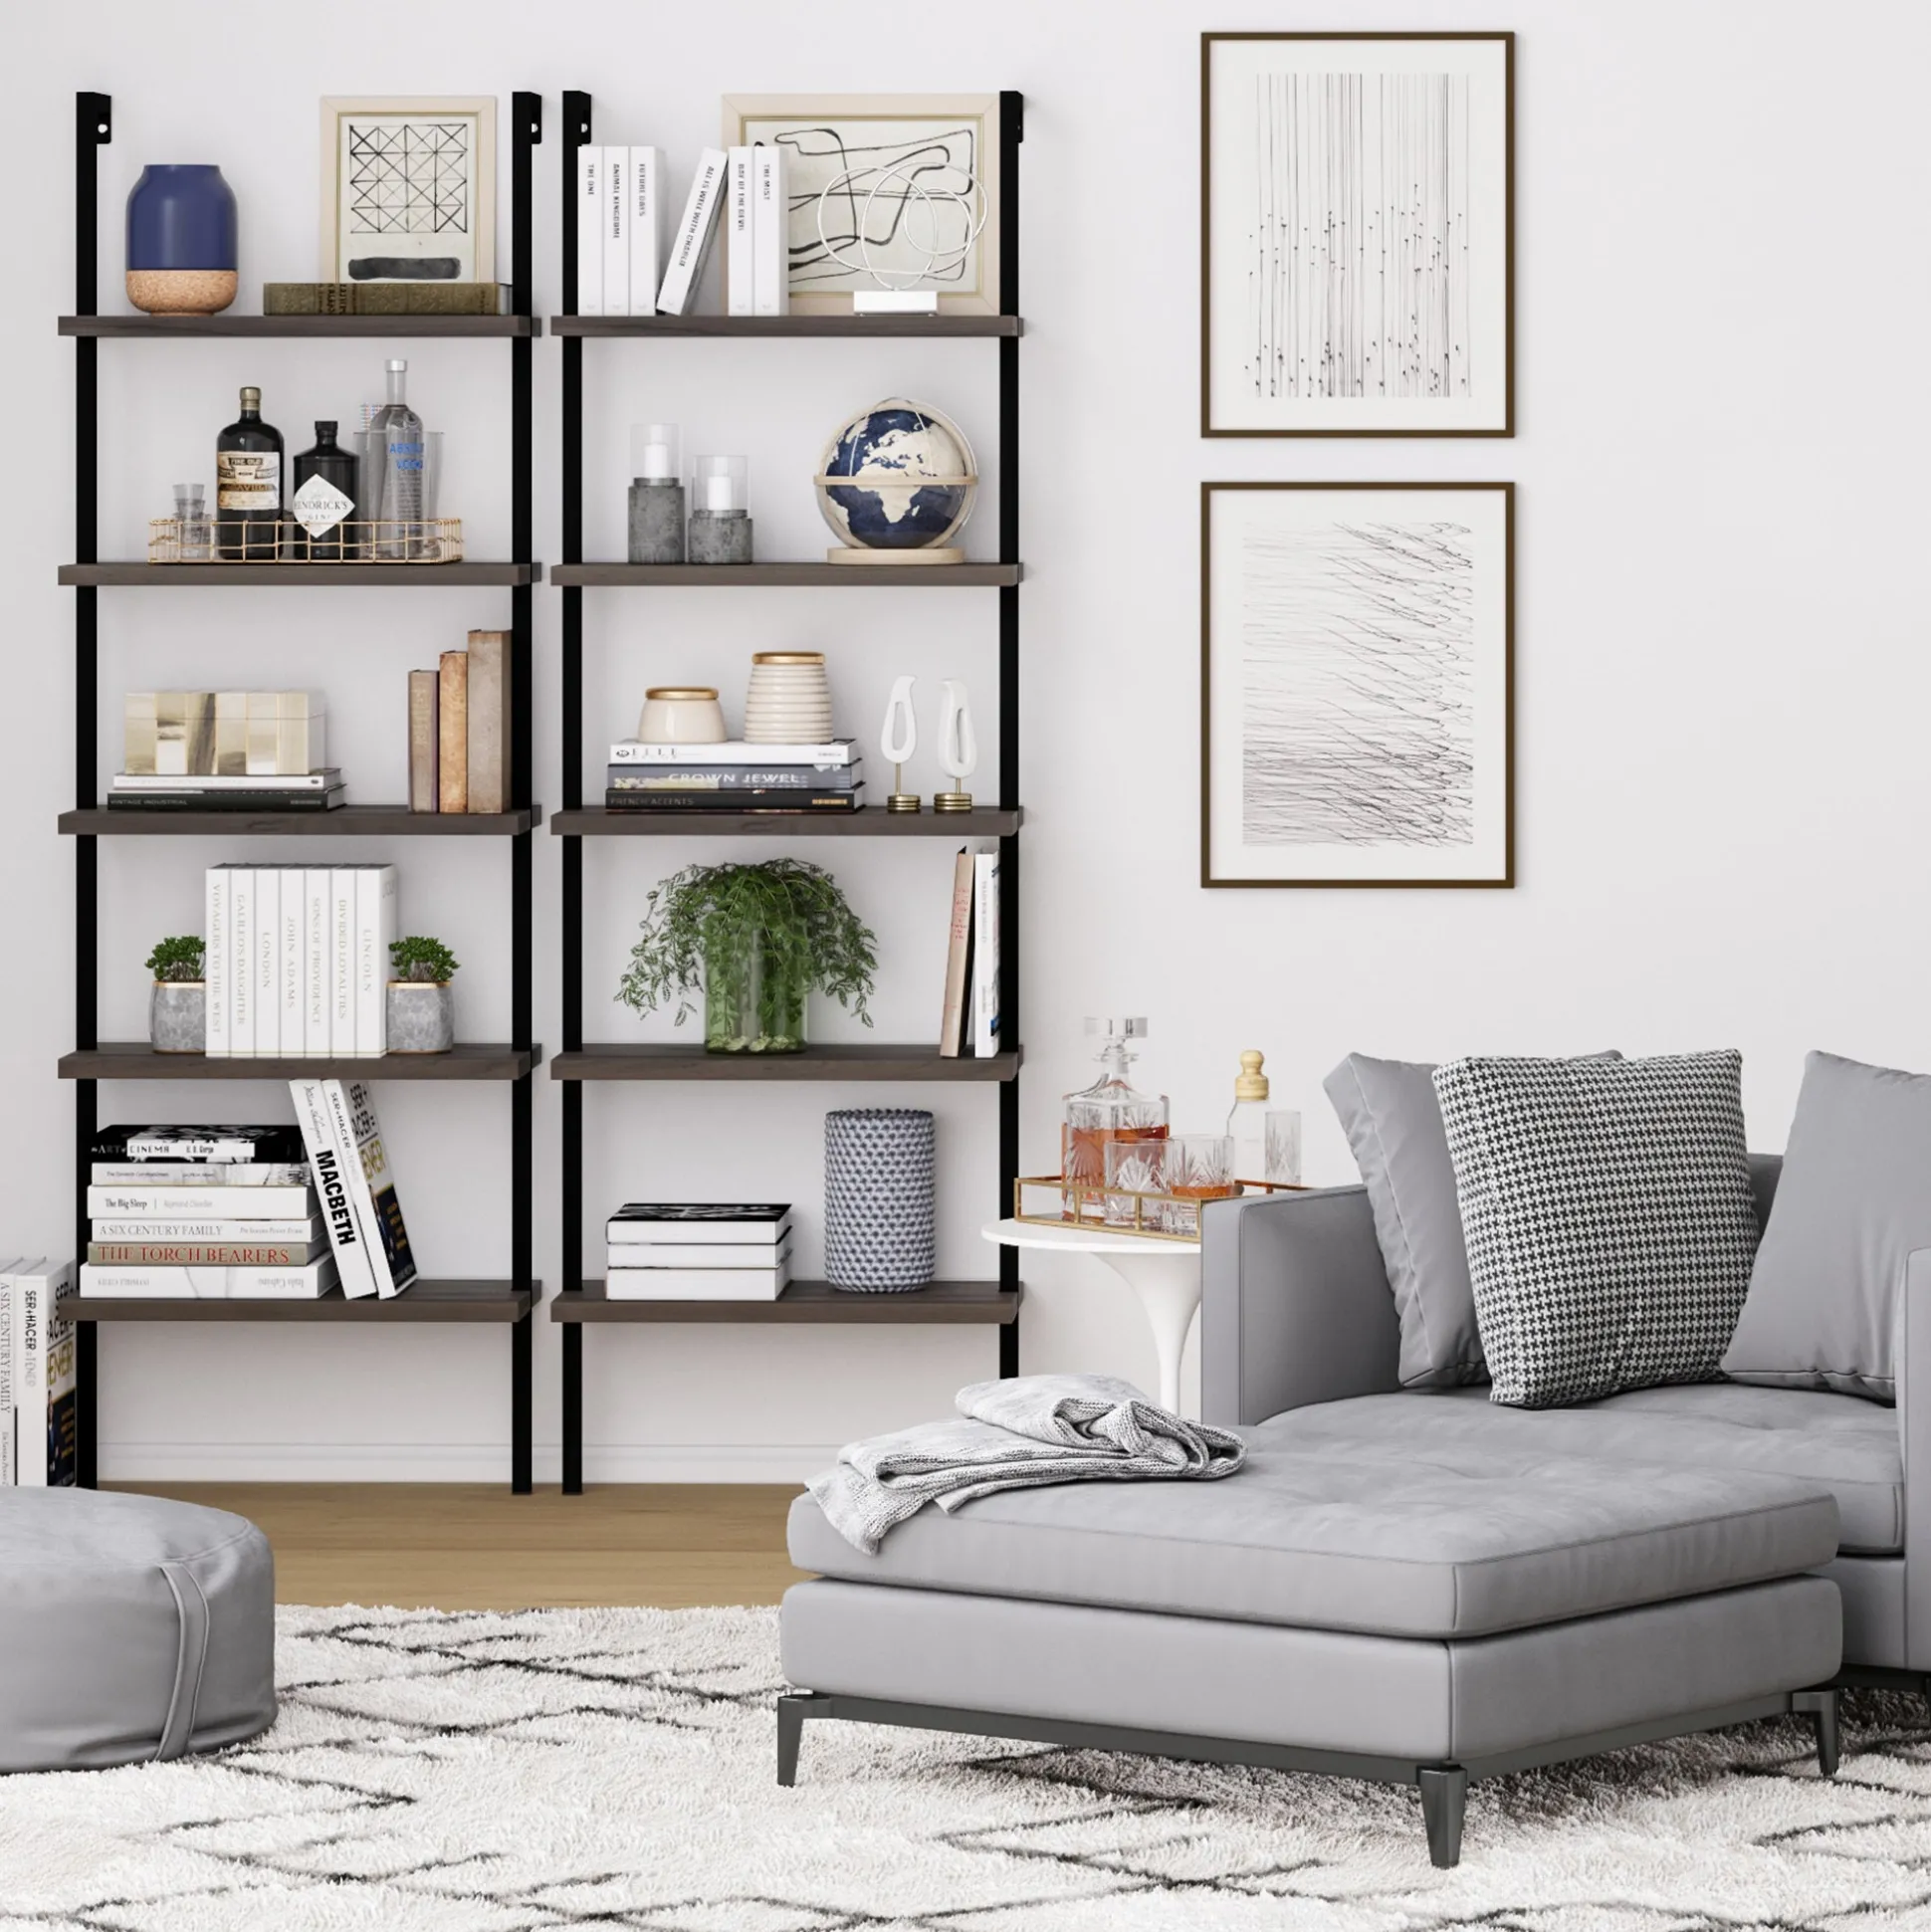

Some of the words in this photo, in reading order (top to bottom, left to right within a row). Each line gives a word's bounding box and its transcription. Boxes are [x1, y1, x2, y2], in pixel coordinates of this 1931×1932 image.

[668, 773, 736, 782] CROWN
[212, 954, 221, 969] TO
[363, 929, 372, 991] LINCOLN
[287, 959, 296, 1008] ADAMS
[105, 1198, 116, 1207] The
[117, 1198, 129, 1210] Big
[130, 1198, 147, 1210] Sleep
[316, 1150, 356, 1245] MACBETH
[108, 1225, 125, 1235] SIX
[127, 1225, 179, 1235] CENTURY
[182, 1225, 222, 1235] FAMILY
[98, 1246, 134, 1261] THE
[140, 1247, 201, 1262] TORCH
[206, 1248, 290, 1263] BEARERS
[0, 1291, 10, 1311] SIX
[0, 1313, 11, 1368] CENTURY
[1, 1370, 11, 1413] FAMILY
